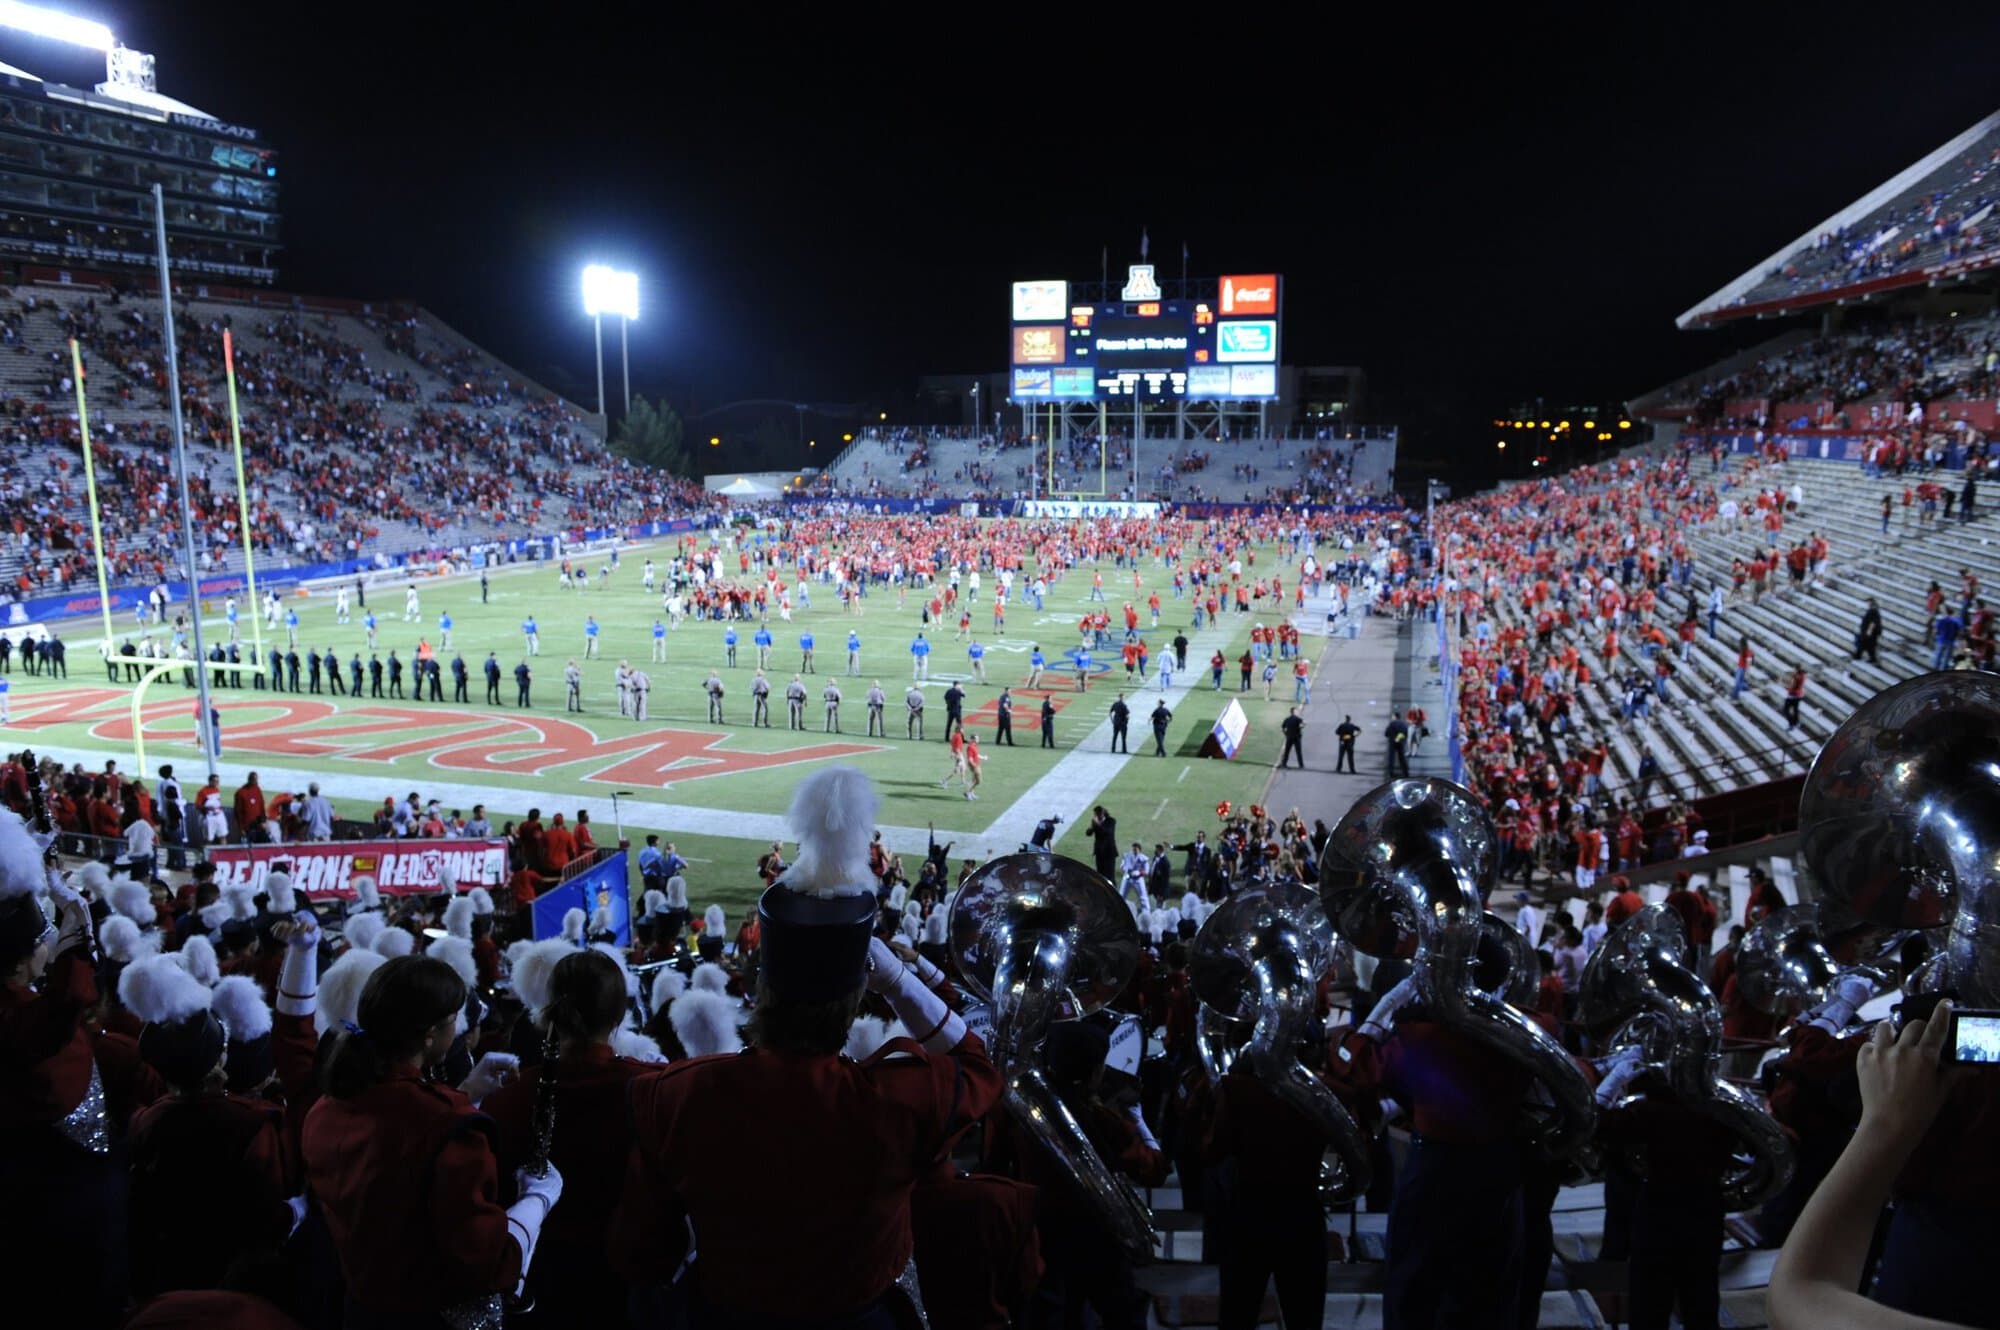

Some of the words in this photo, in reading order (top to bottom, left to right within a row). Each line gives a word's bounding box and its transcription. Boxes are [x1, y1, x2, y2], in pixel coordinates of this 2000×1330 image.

[173, 113, 256, 139] WILDCATS
[1122, 265, 1161, 301] A
[0, 687, 897, 790] ARIZON
[213, 860, 268, 892] RED
[294, 854, 353, 891] ZONE
[379, 854, 422, 886] RED
[442, 850, 485, 883] ZONE
[1111, 1023, 1136, 1049] YAMAHA
